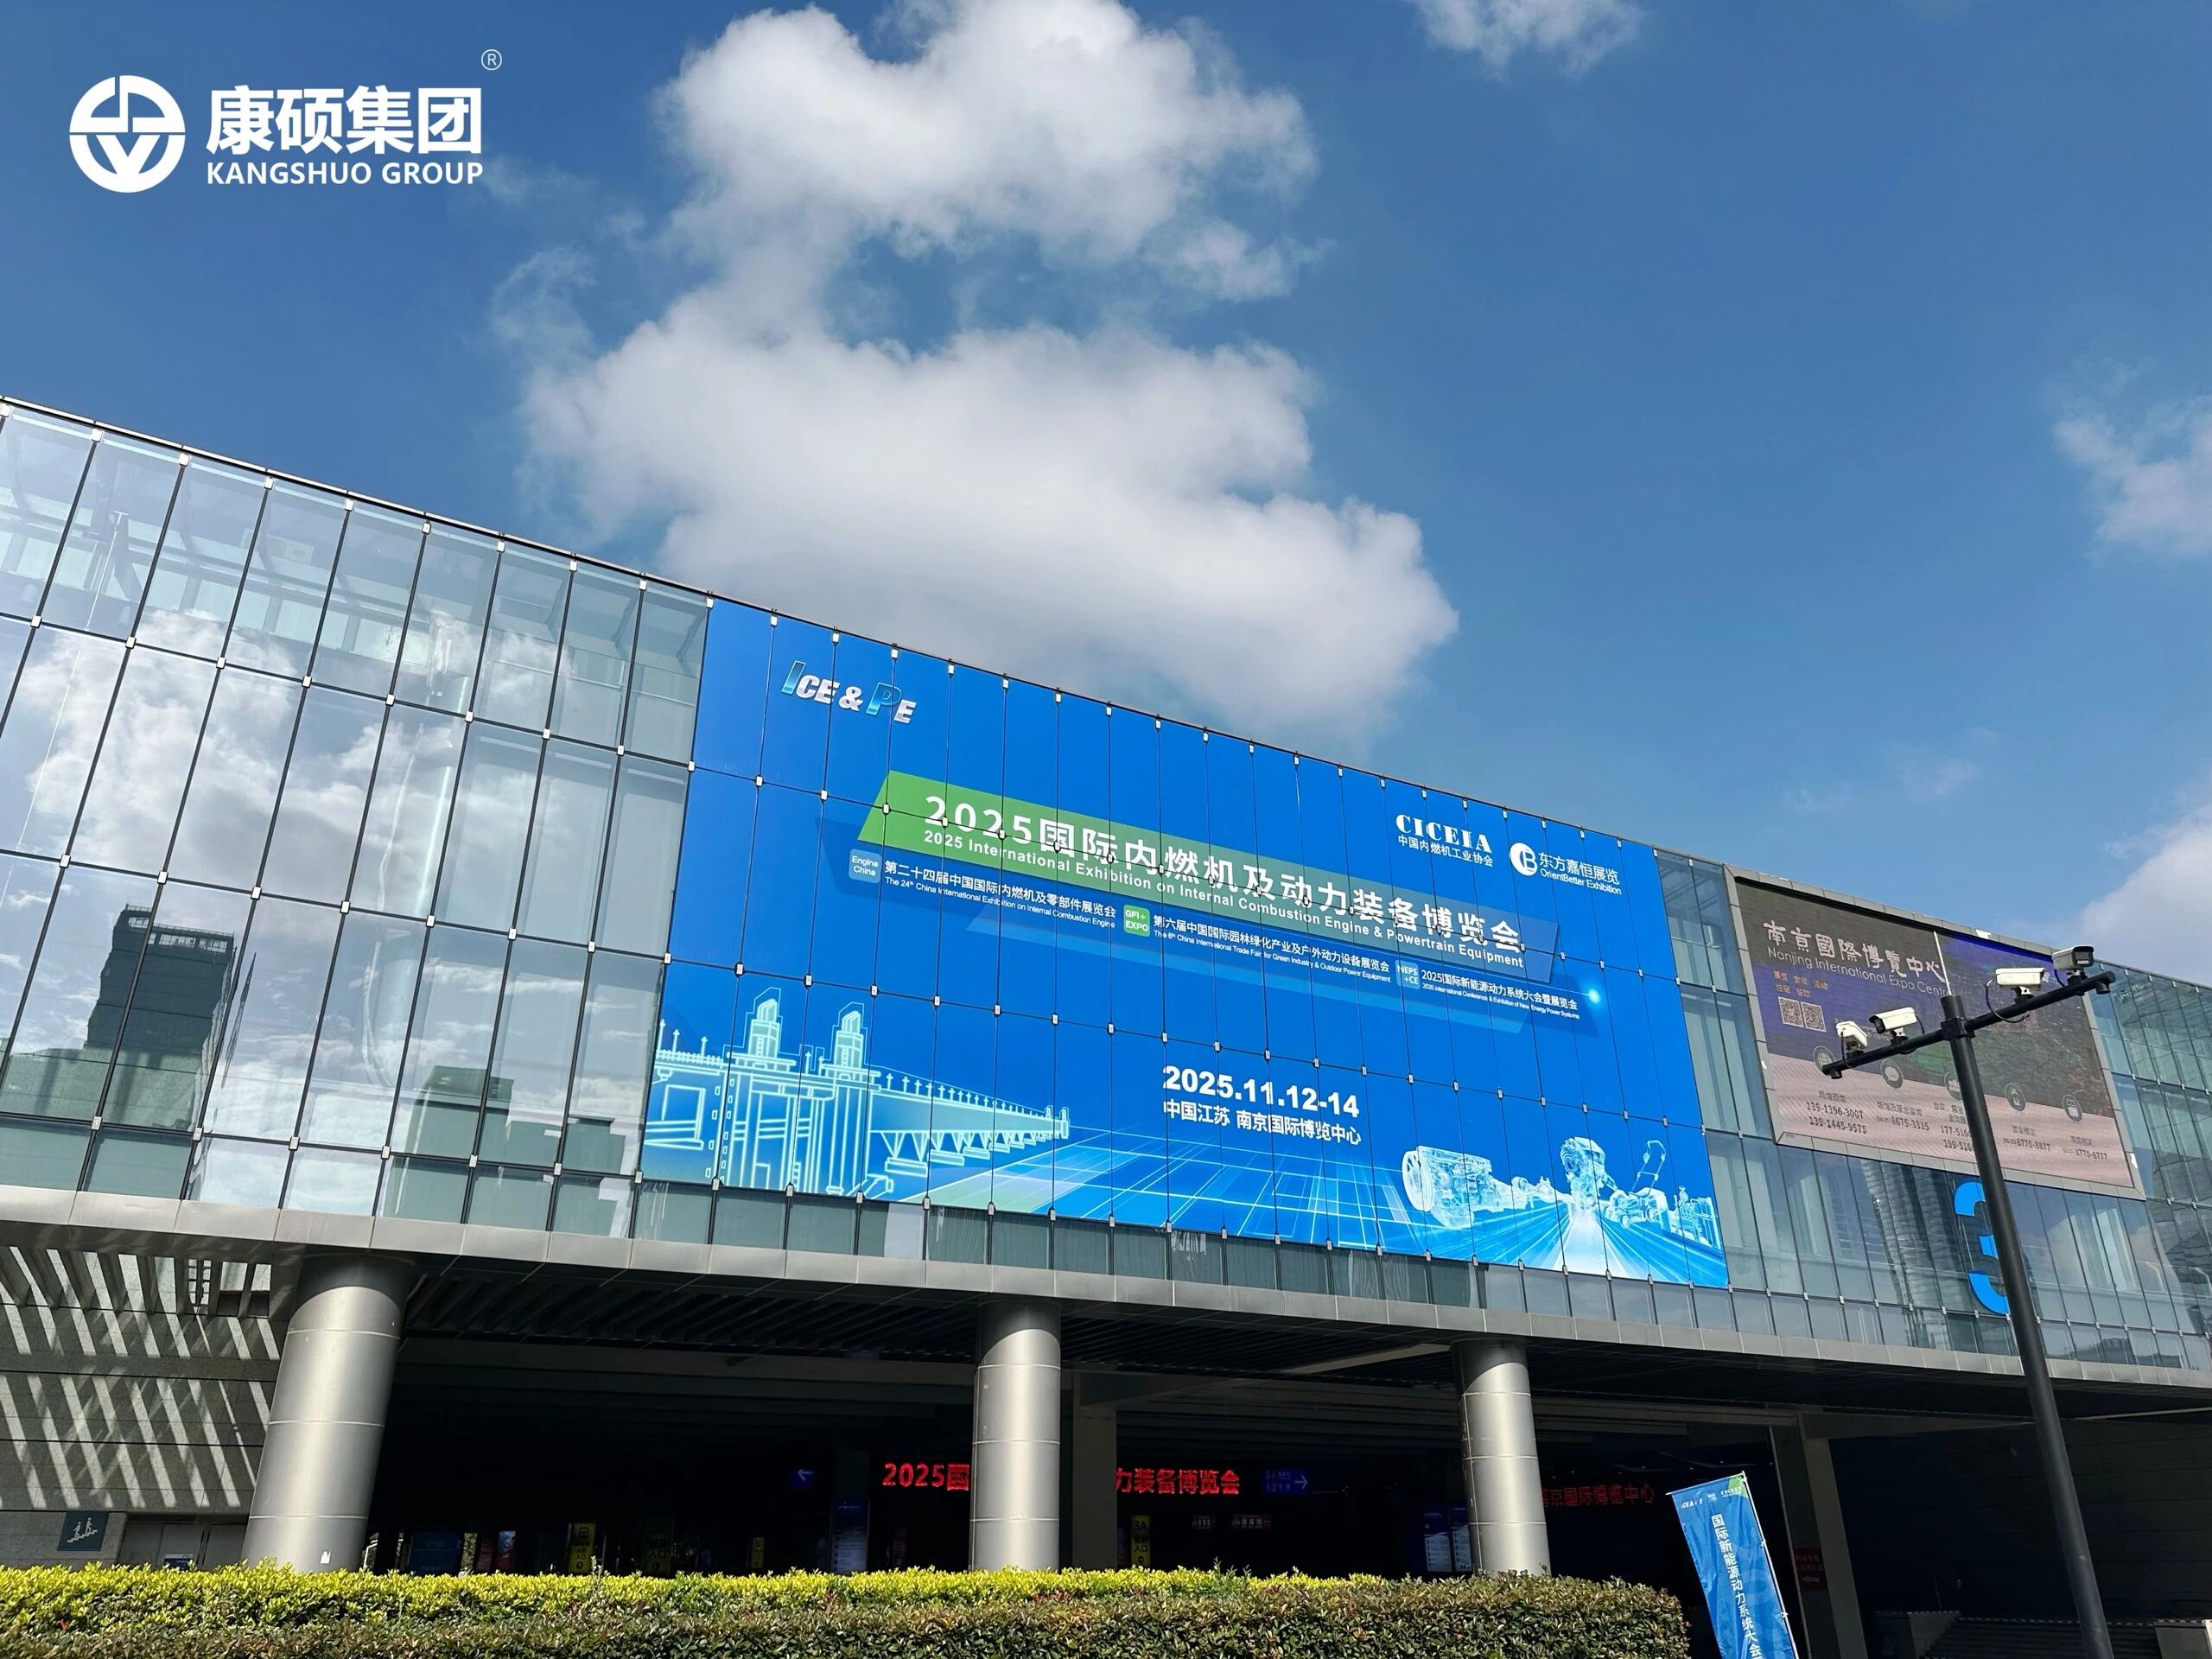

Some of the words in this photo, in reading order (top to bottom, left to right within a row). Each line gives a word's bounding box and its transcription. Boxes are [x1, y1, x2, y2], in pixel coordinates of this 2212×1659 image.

[1395, 814, 1492, 853] CICEIA
[1398, 834, 1493, 867] 中国内燃机工业协会
[852, 855, 879, 868] Engine
[854, 866, 876, 876] China
[925, 796, 1524, 954] 2025国际内燃机及动力装备博览会
[1538, 851, 1620, 885] 东方嘉恒展览
[885, 861, 1116, 918] 第二十四届中国国际内燃机及零部件展览会
[924, 830, 963, 849] 2025
[969, 839, 1070, 872] International
[1076, 862, 1151, 889] Exhibition
[1157, 880, 1175, 894] on
[1180, 885, 1233, 906] Internal
[1239, 897, 1319, 925] Combustion
[1325, 916, 1369, 936] Engine
[1374, 926, 1382, 938] &
[1388, 928, 1454, 953] Powertrain
[1459, 944, 1522, 968] Equipment
[1541, 868, 1585, 887] OrientBetter
[1586, 879, 1622, 895] Exhibition
[885, 876, 899, 886] The
[916, 883, 936, 893] China
[938, 887, 981, 901] International
[982, 895, 1016, 908] Exhibition
[1027, 905, 1052, 916] Internal
[1052, 910, 1090, 924] Combustion
[1092, 918, 1116, 929] Engine
[1125, 920, 1148, 931] EXPO
[1177, 935, 1195, 944] China
[1232, 945, 1249, 956] Trade
[1273, 953, 1290, 963] Green
[1291, 957, 1313, 969] Industry
[1767, 947, 1812, 969] Nanjing
[1815, 957, 1887, 984] International
[1889, 975, 1915, 991] Expo
[1916, 981, 1951, 997] Centr
[1162, 1065, 1359, 1118] 2025.11.12-14
[1163, 1098, 1230, 1127] 中国江苏
[1236, 1109, 1362, 1146] 南京国际博览中心
[1941, 1125, 1971, 1138] 177-510
[1711, 1514, 1764, 1659] 国际新能源动力系统大会
